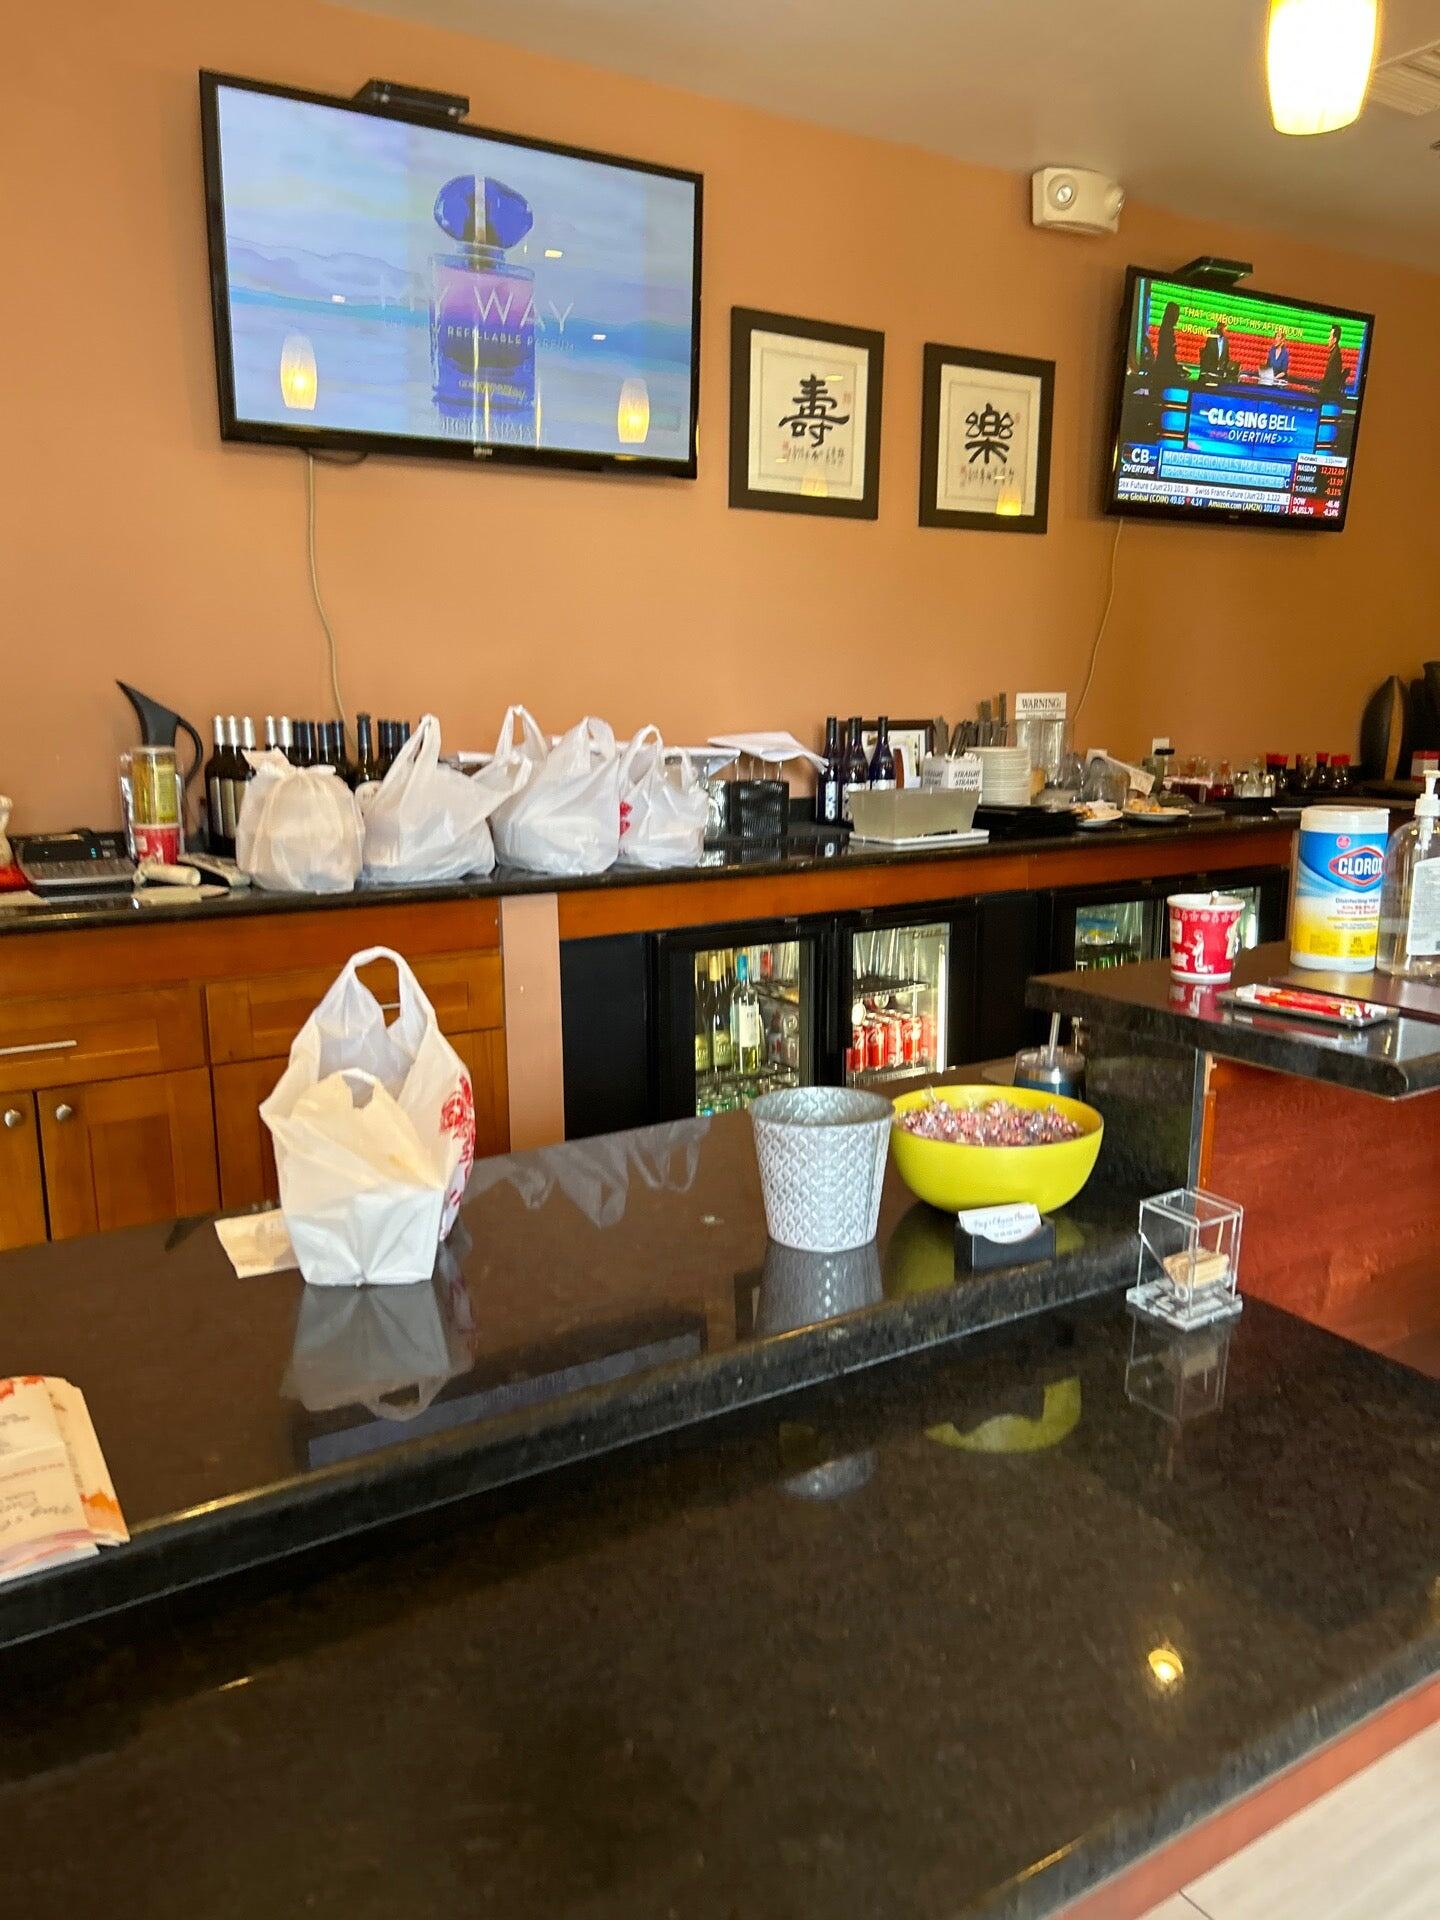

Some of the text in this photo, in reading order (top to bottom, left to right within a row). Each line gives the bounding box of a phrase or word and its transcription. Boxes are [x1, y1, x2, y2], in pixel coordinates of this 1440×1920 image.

[474, 286, 574, 334] WAY
[1182, 323, 1211, 336] URGING
[1262, 322, 1304, 337] AFTERNOON
[1208, 408, 1297, 431] CLOSING BELL
[1228, 430, 1277, 444] OVERTIME
[1131, 448, 1149, 464] CB
[1122, 464, 1155, 475] OVERTIME
[1298, 464, 1317, 473] NASDAQ
[1131, 481, 1149, 490] Future
[1195, 487, 1210, 496] Swiss
[1227, 490, 1244, 498] Future
[1130, 493, 1149, 502] Global
[1150, 494, 1169, 504] (COIN)
[1208, 500, 1242, 510] Amazon.com
[1242, 502, 1263, 512] (AMZN)
[1293, 497, 1306, 505] DOW
